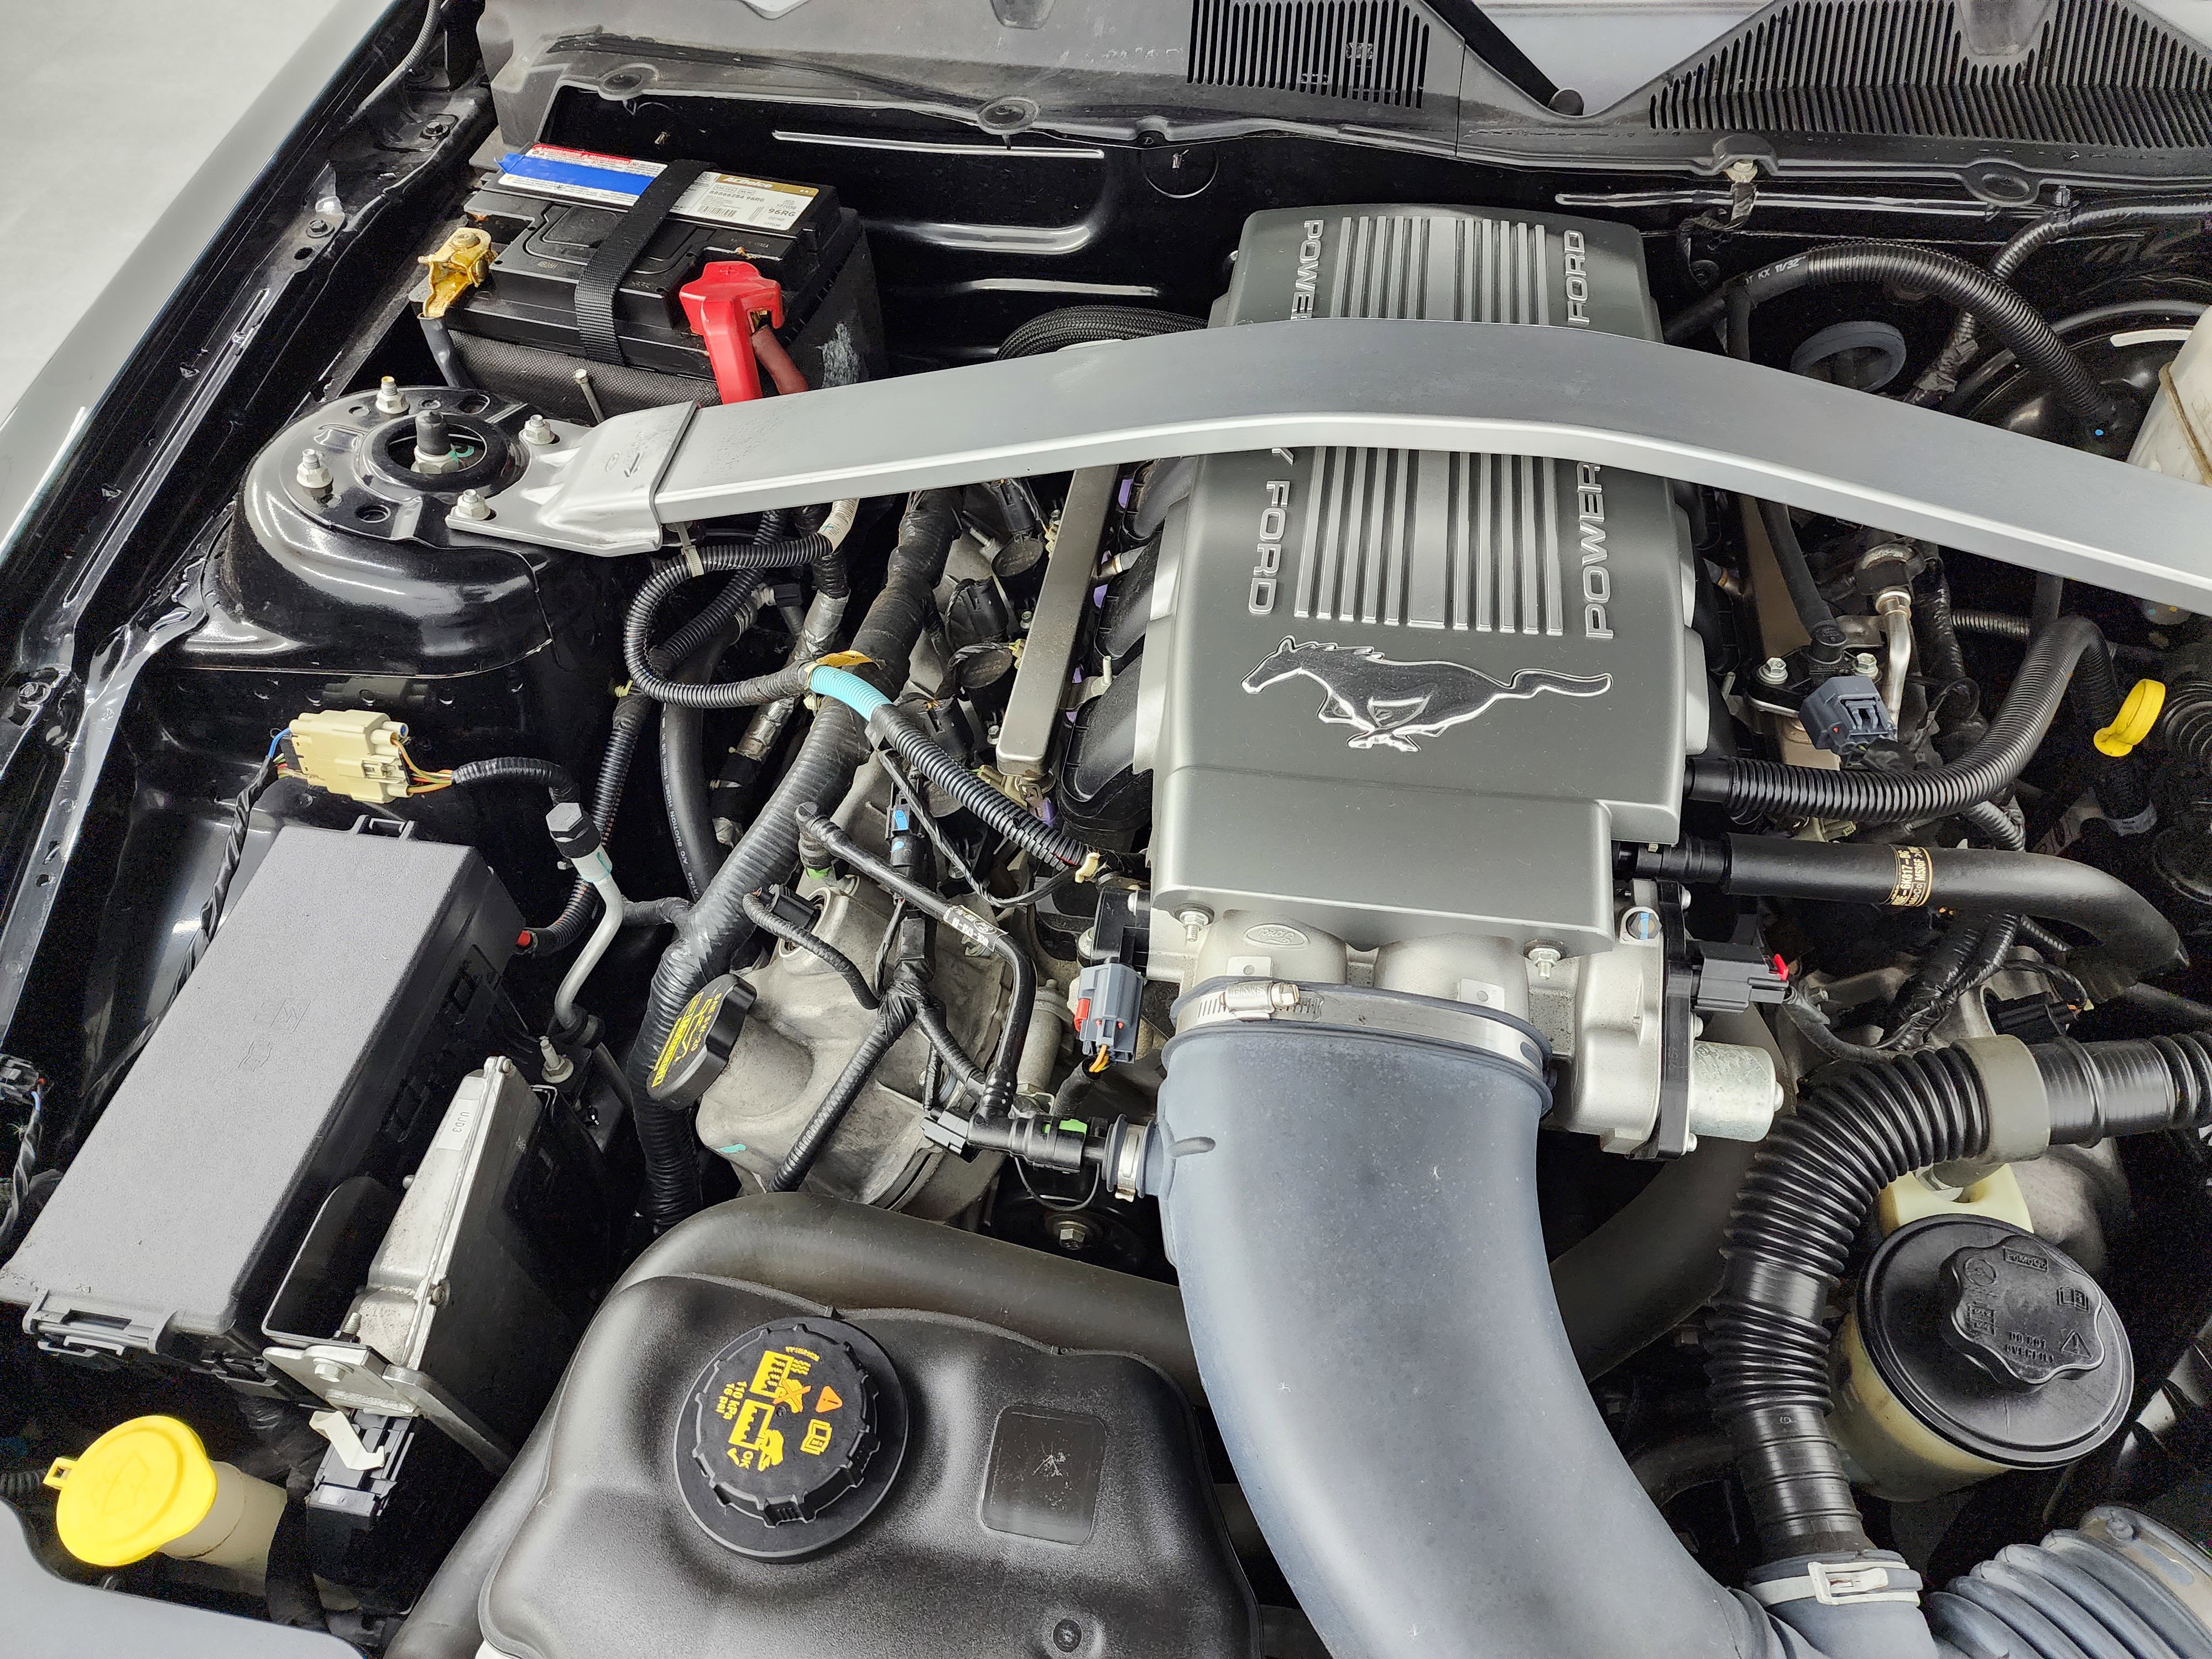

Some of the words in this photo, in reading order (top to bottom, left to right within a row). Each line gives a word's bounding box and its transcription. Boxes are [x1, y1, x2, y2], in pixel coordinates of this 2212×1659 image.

[722, 176, 773, 189] ACDelco
[768, 208, 796, 217] 96RG
[1563, 229, 1590, 326] FORD
[1248, 481, 1291, 615] FORD
[665, 784, 673, 807] HOSE
[708, 993, 722, 1014] SAE
[452, 1112, 470, 1134] UJD3
[2006, 1251, 2047, 1269] FoMoCo
[723, 1383, 735, 1396] 16
[733, 1381, 747, 1400] 110
[716, 1396, 729, 1414] psi
[722, 1400, 740, 1421] kPa
[739, 1450, 754, 1469] OK
